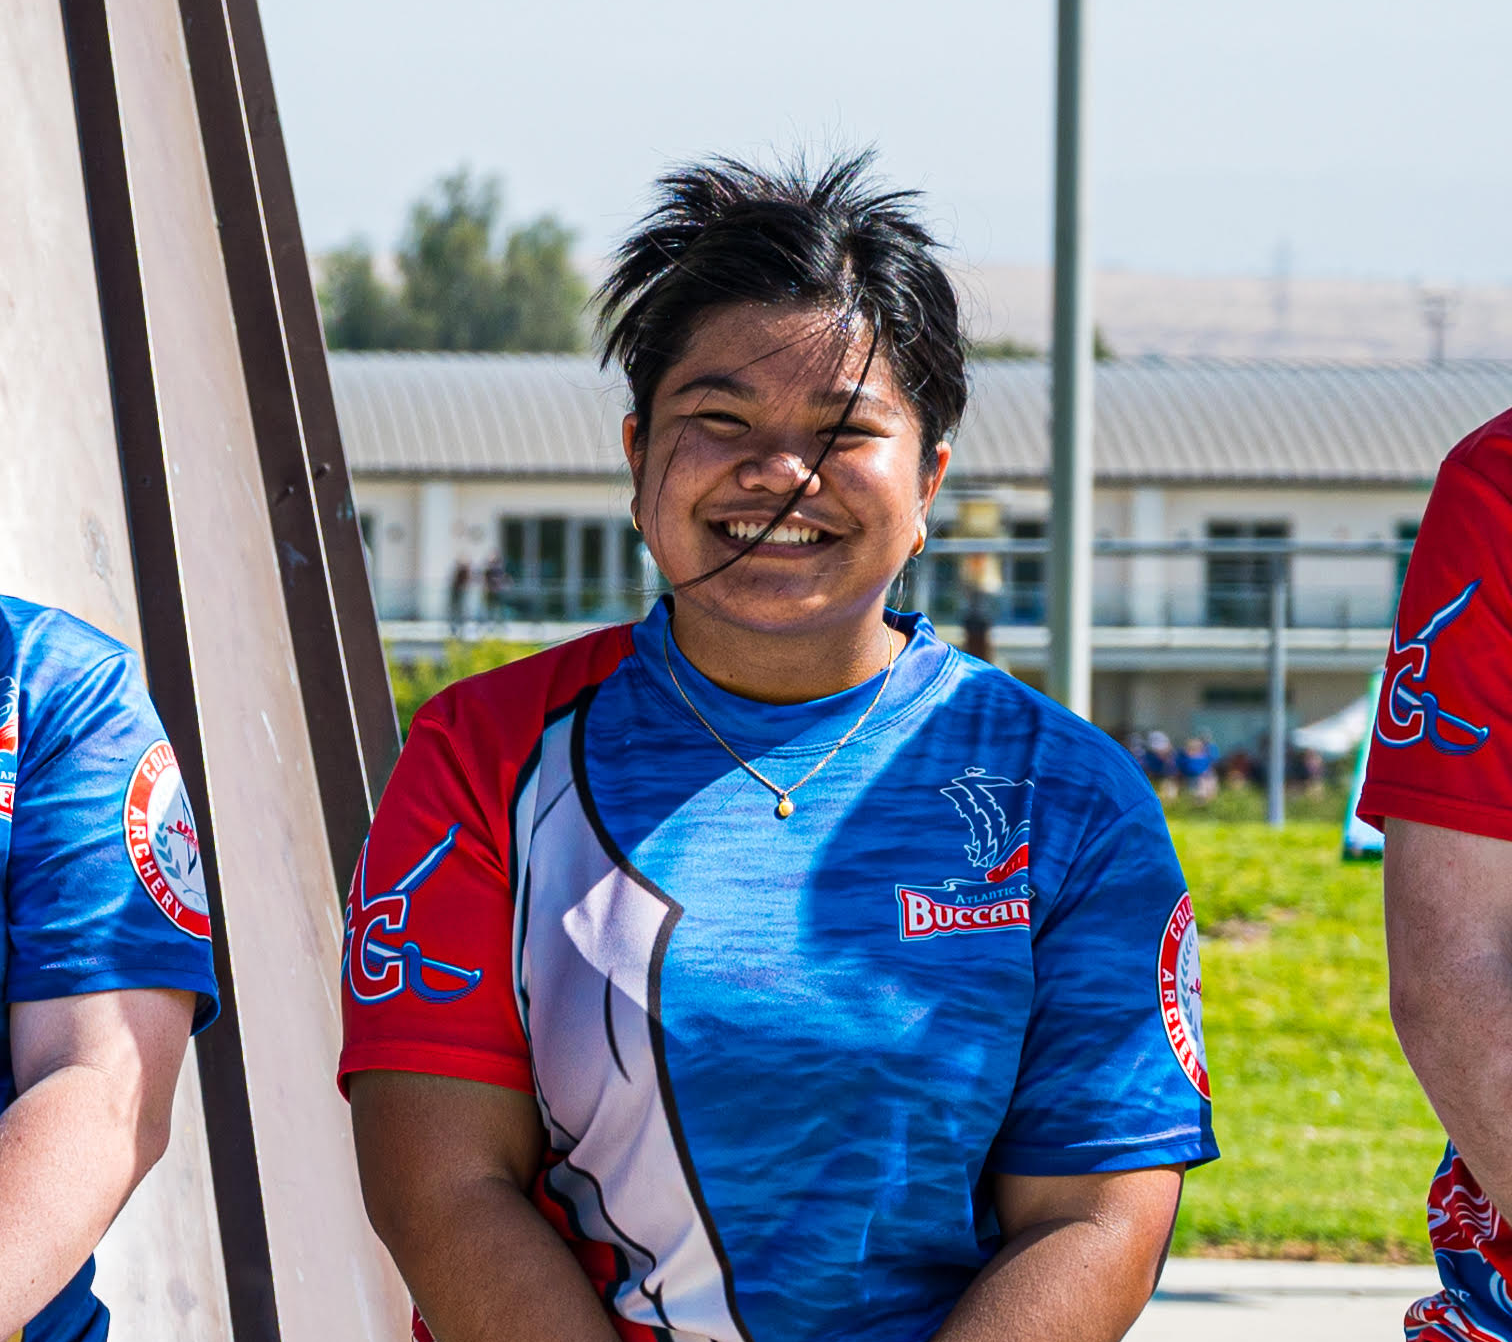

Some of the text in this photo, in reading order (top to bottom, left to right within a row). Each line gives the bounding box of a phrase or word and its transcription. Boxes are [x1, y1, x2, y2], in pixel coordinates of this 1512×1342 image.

[130, 806, 183, 920] ARCHERY
[956, 886, 1015, 905] ATLANTIC
[1161, 967, 1202, 1085] ARCHERY
